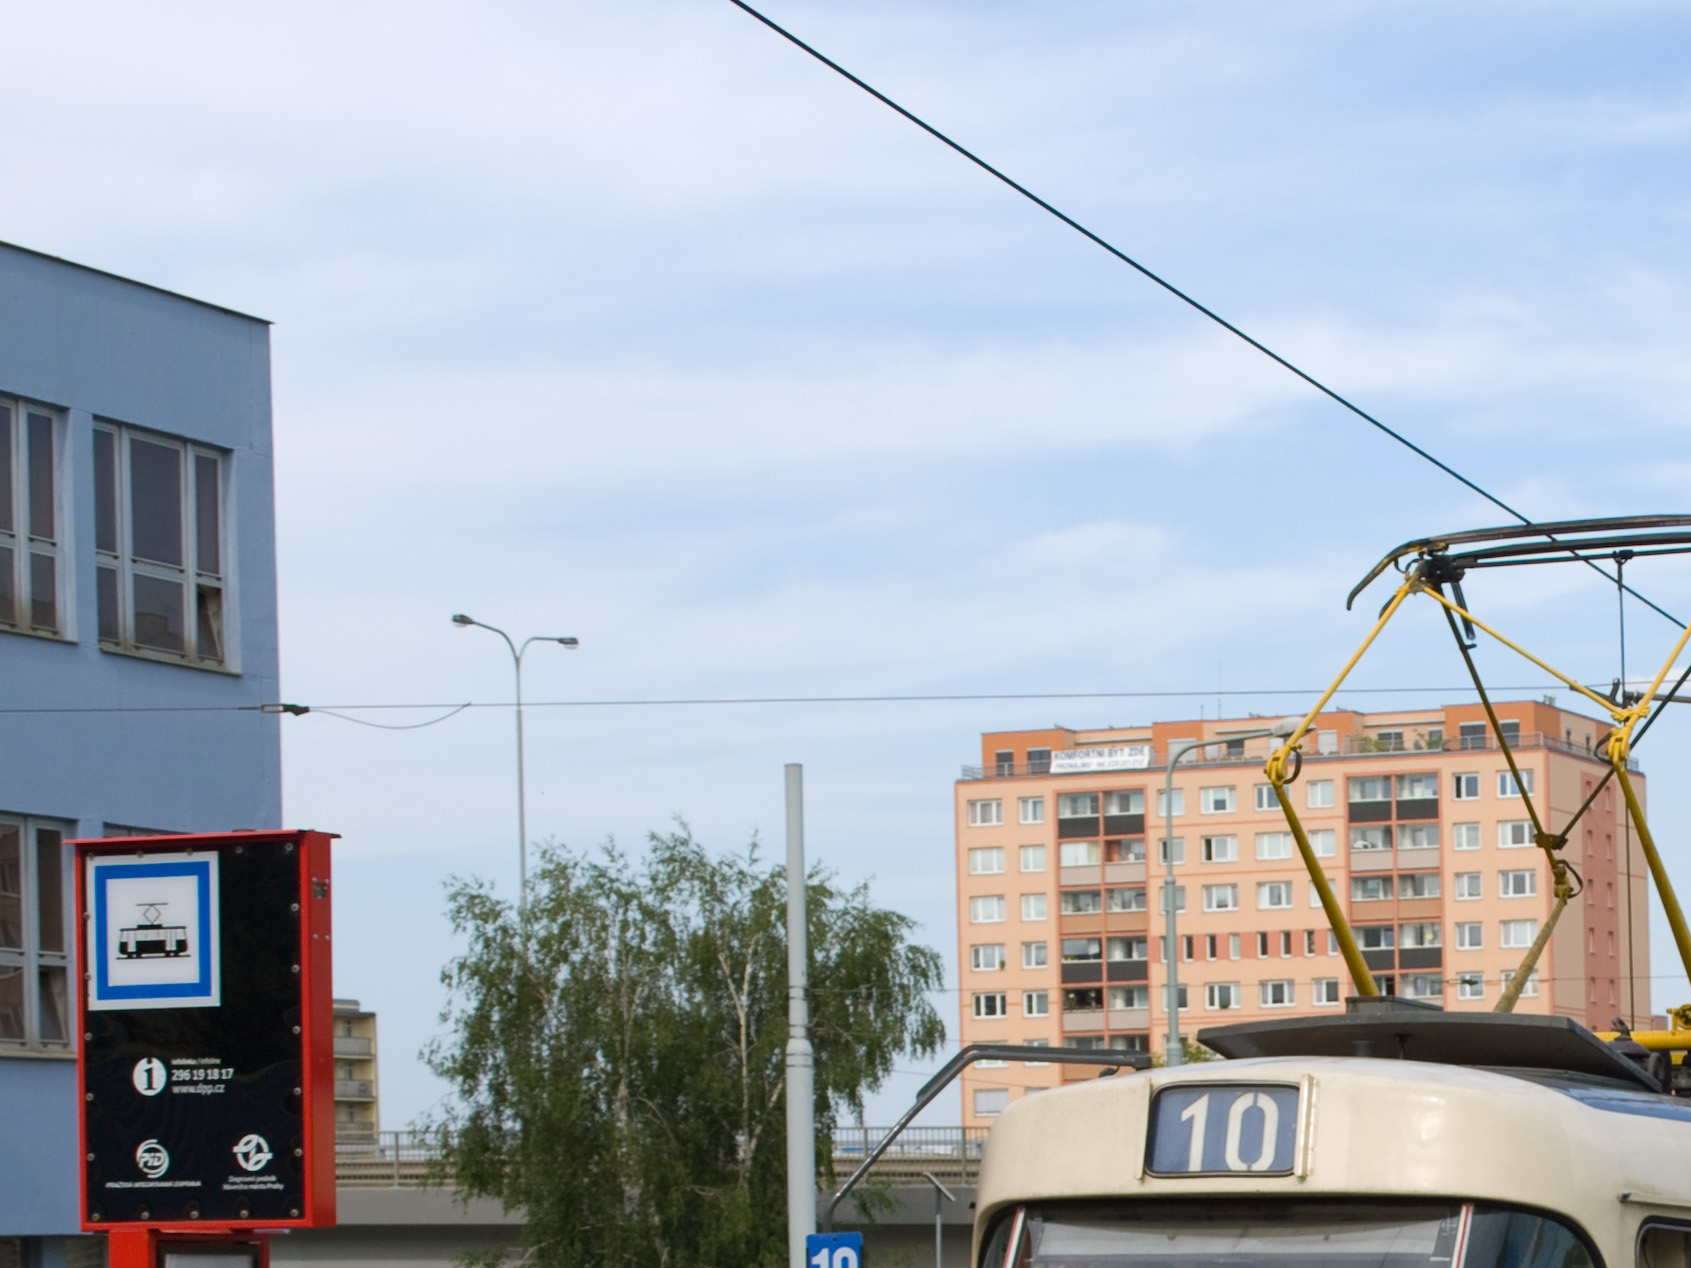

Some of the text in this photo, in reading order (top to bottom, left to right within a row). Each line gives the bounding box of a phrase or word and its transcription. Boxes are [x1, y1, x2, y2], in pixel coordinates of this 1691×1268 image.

[171, 1067, 234, 1081] 296 19 18 17
[1181, 1092, 1279, 1172] 10
